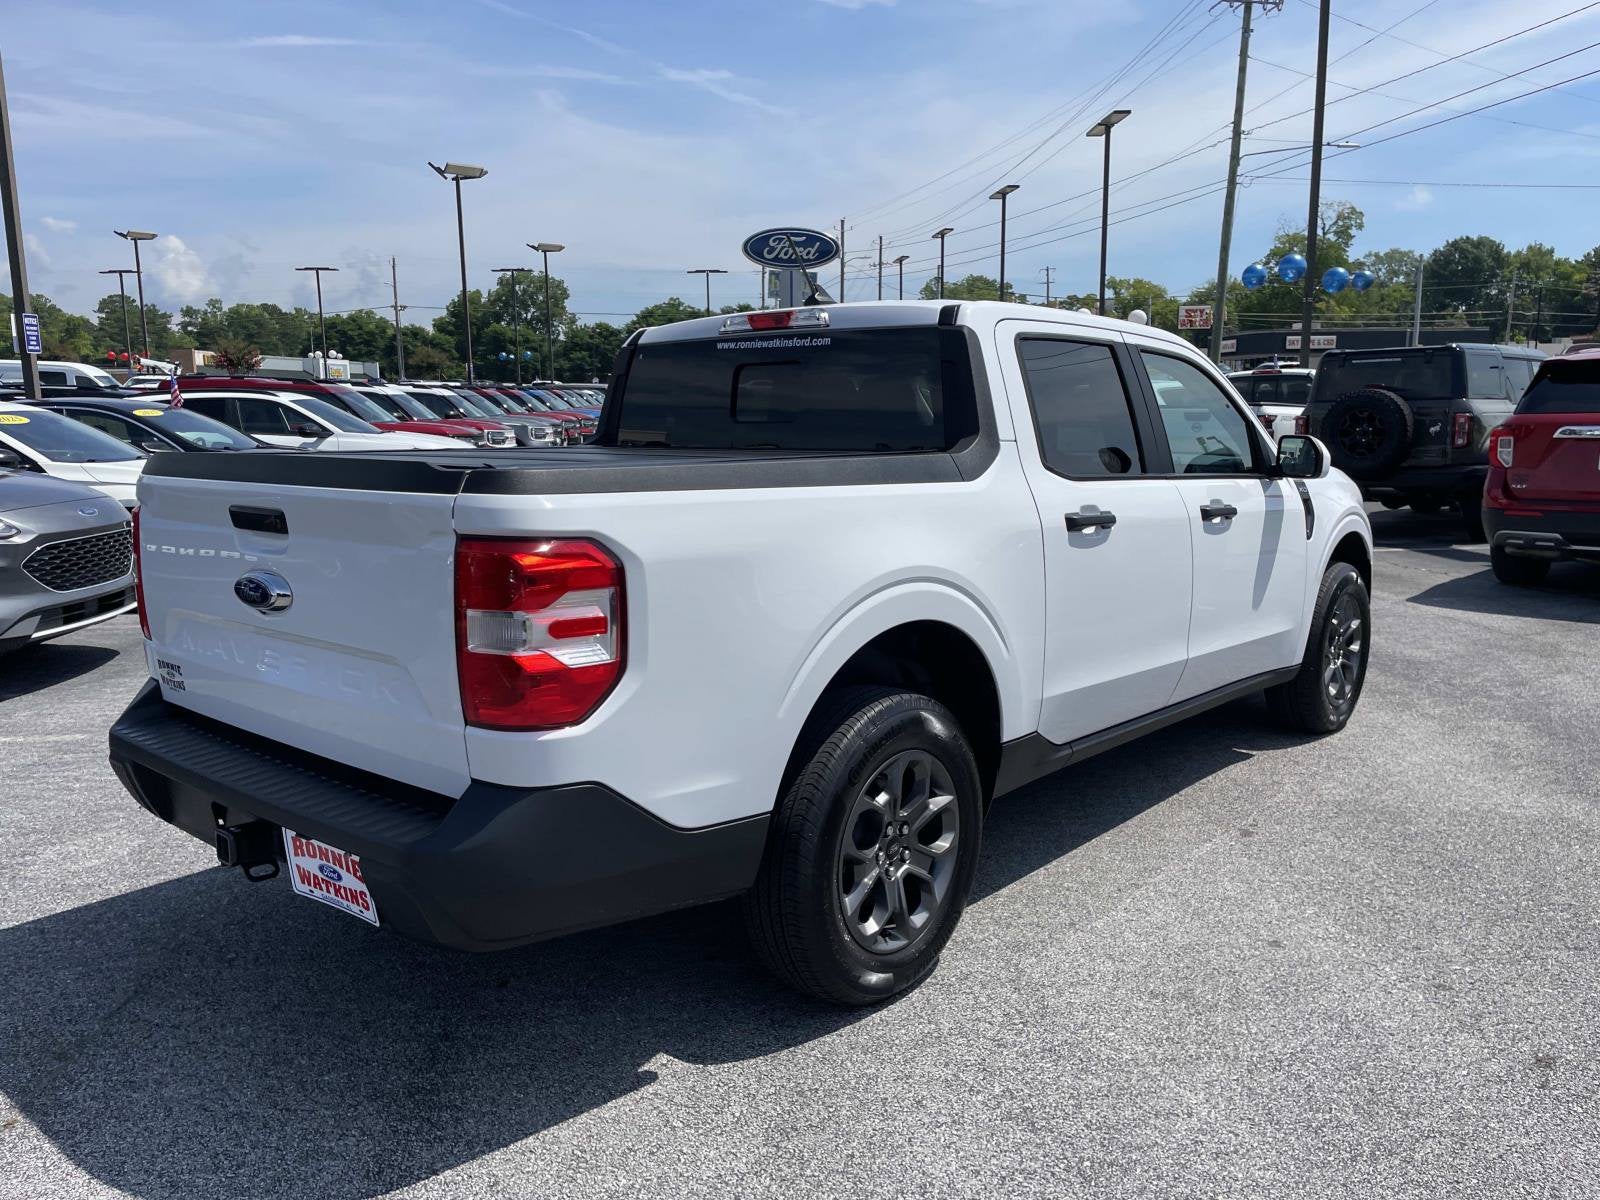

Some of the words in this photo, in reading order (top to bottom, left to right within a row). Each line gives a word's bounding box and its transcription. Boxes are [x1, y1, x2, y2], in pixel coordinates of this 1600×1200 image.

[763, 235, 821, 260] Ford
[716, 335, 832, 350] www.ronniewatkinsford.com
[291, 836, 366, 885] RONNIE
[322, 865, 339, 880] Ford
[295, 863, 371, 912] WATKINS
